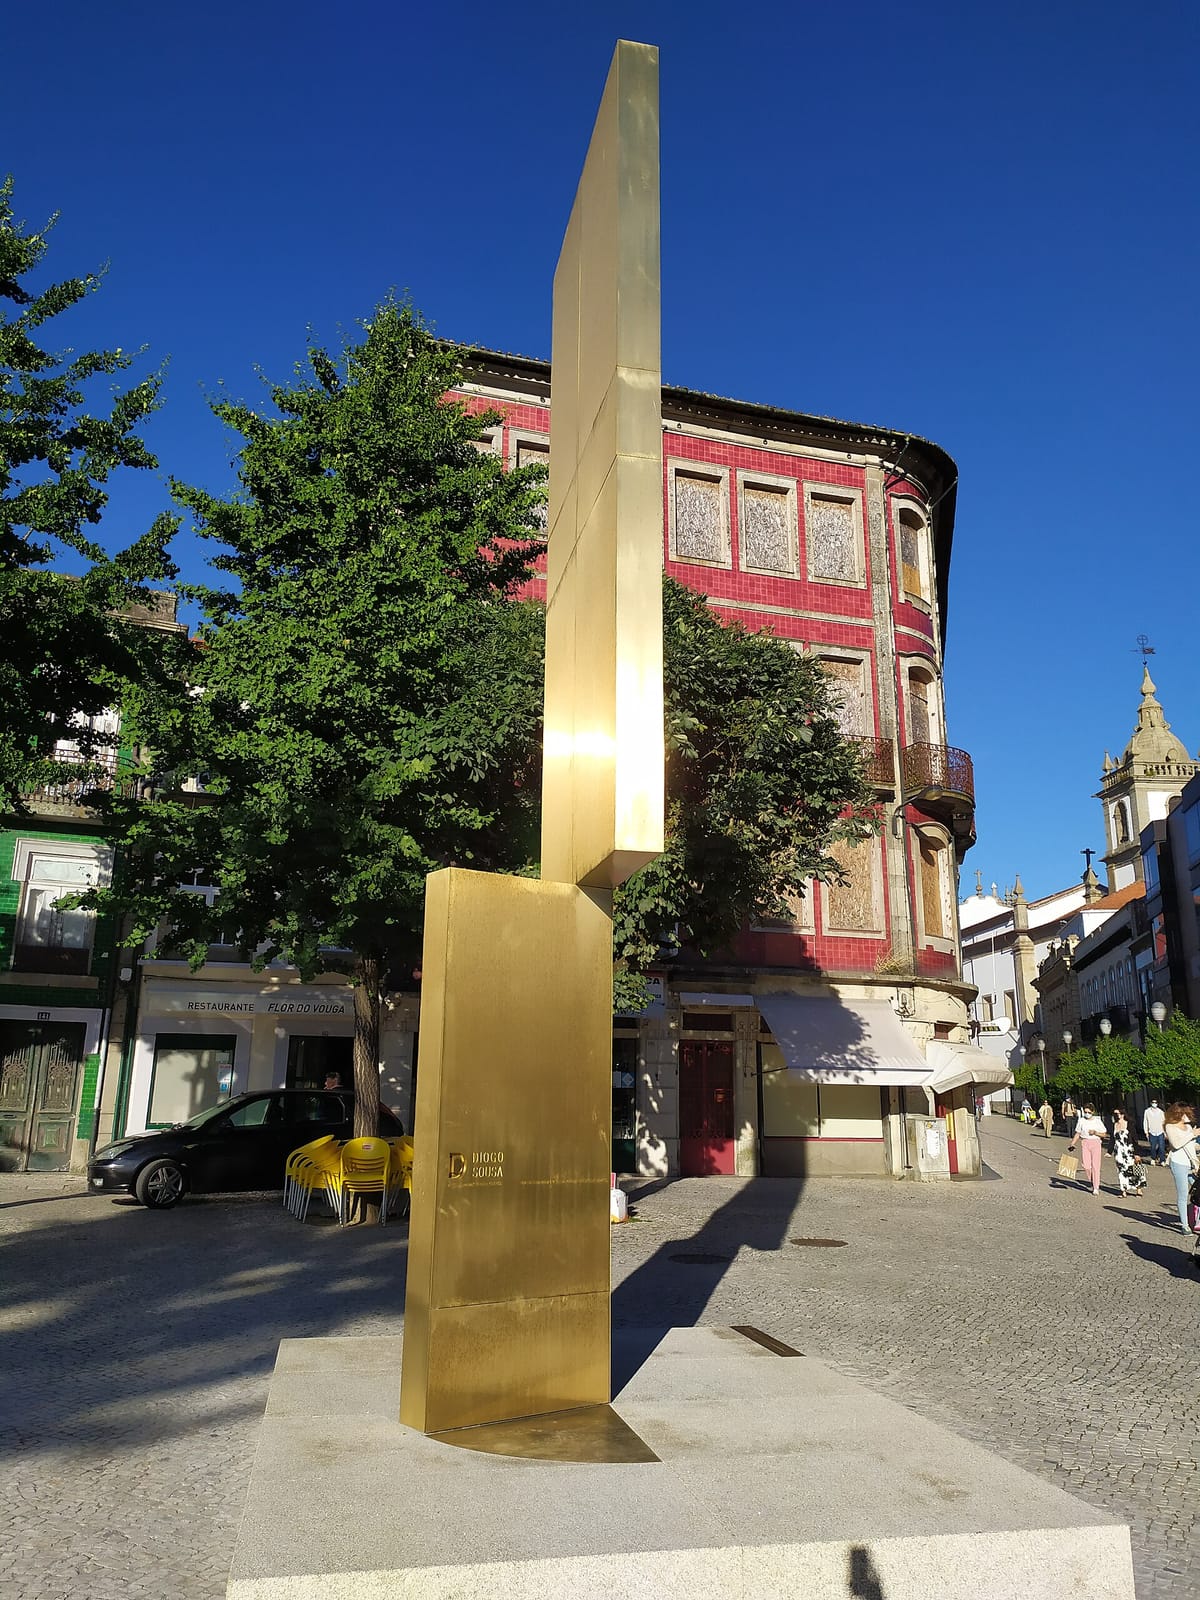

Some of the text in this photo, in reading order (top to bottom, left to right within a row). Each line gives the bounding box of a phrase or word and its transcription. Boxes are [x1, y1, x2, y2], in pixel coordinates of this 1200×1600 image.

[187, 1001, 345, 1014] RESTAURANTE FLOR DO VOUGA
[472, 1151, 504, 1163] DIOGO
[472, 1166, 503, 1178] SOUSA
